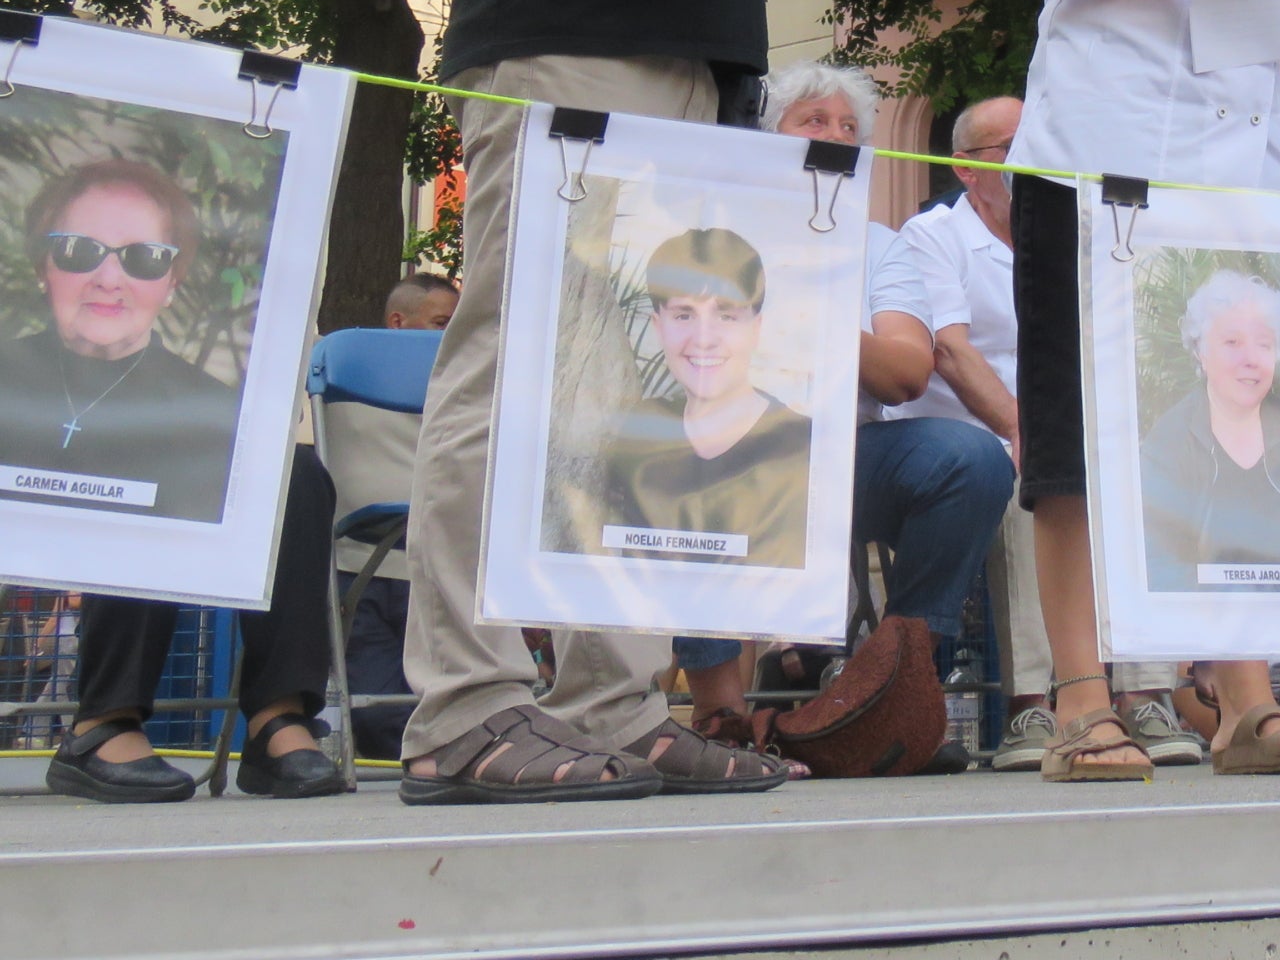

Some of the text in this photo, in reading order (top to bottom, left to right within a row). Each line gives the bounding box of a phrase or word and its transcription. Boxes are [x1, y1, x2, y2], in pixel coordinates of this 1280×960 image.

[15, 474, 124, 499] CARMEN AGUILAR
[625, 533, 662, 547] NOELIA
[1223, 570, 1256, 581] TERESA
